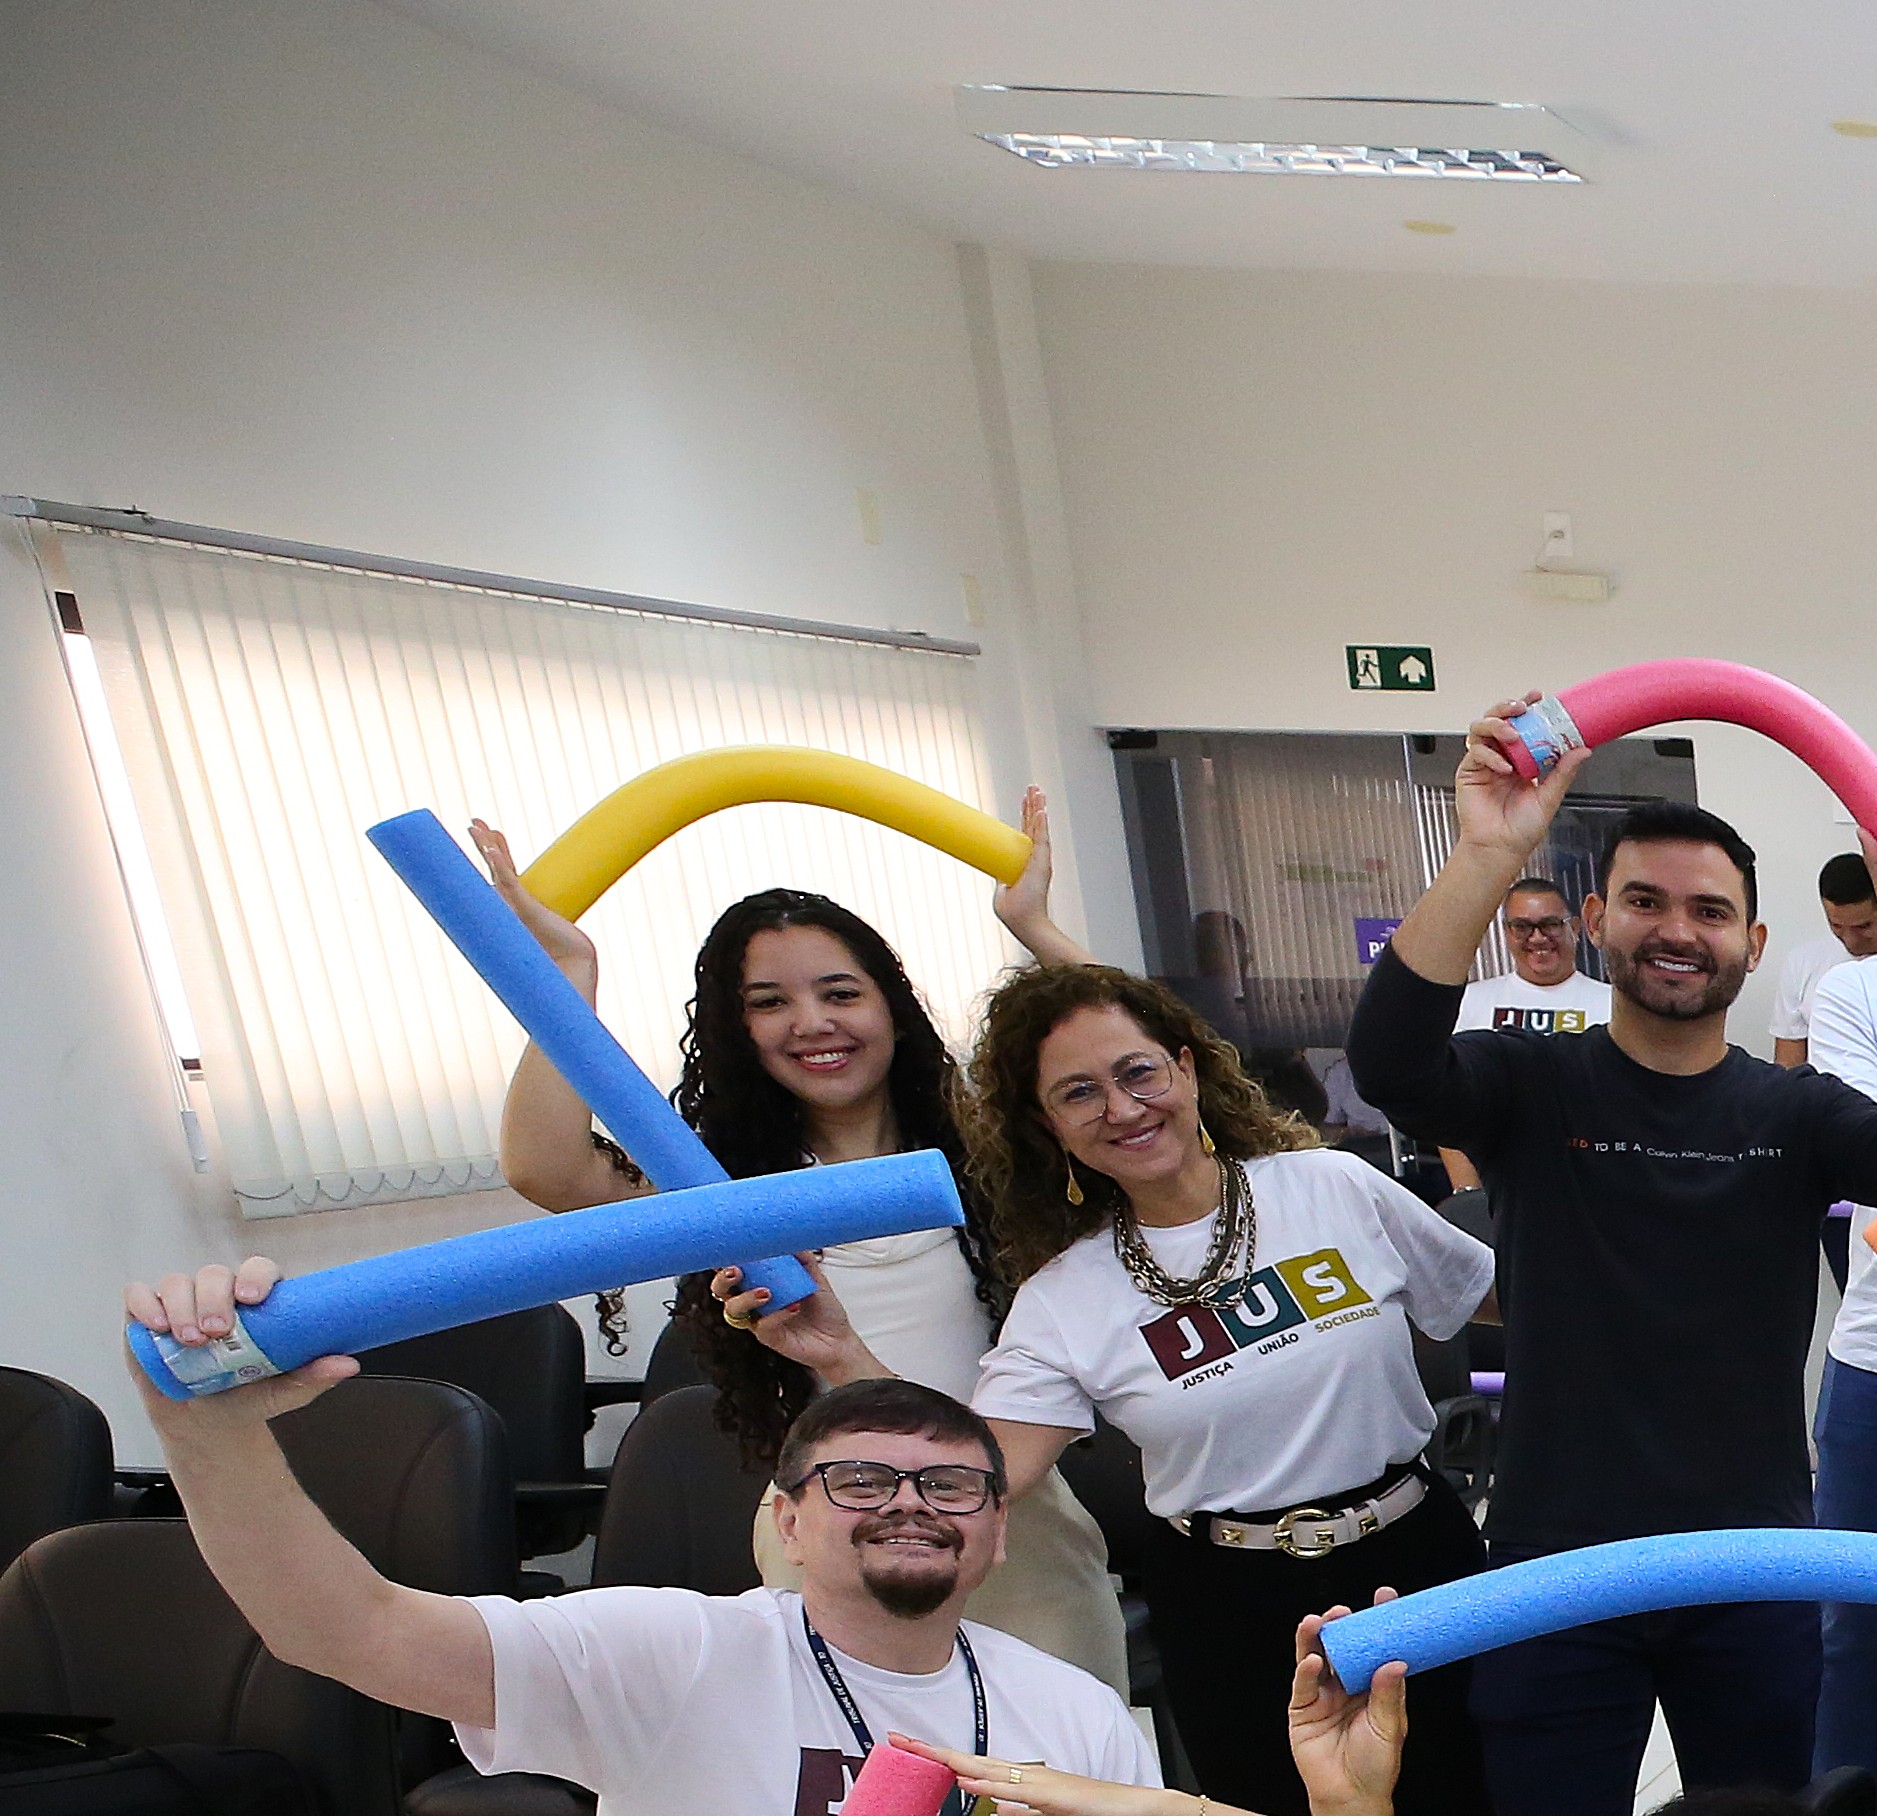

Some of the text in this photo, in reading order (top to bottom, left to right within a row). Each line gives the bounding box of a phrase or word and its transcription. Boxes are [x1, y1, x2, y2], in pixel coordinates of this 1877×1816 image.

[1501, 1010, 1579, 1031] JUS
[1594, 1143, 1609, 1152] TO
[1615, 1142, 1627, 1151] BE
[1633, 1142, 1642, 1151] A
[1176, 1261, 1349, 1360] JUS
[1182, 1306, 1381, 1391] JUSTIÇA UNIÃO SOCIEDADE
